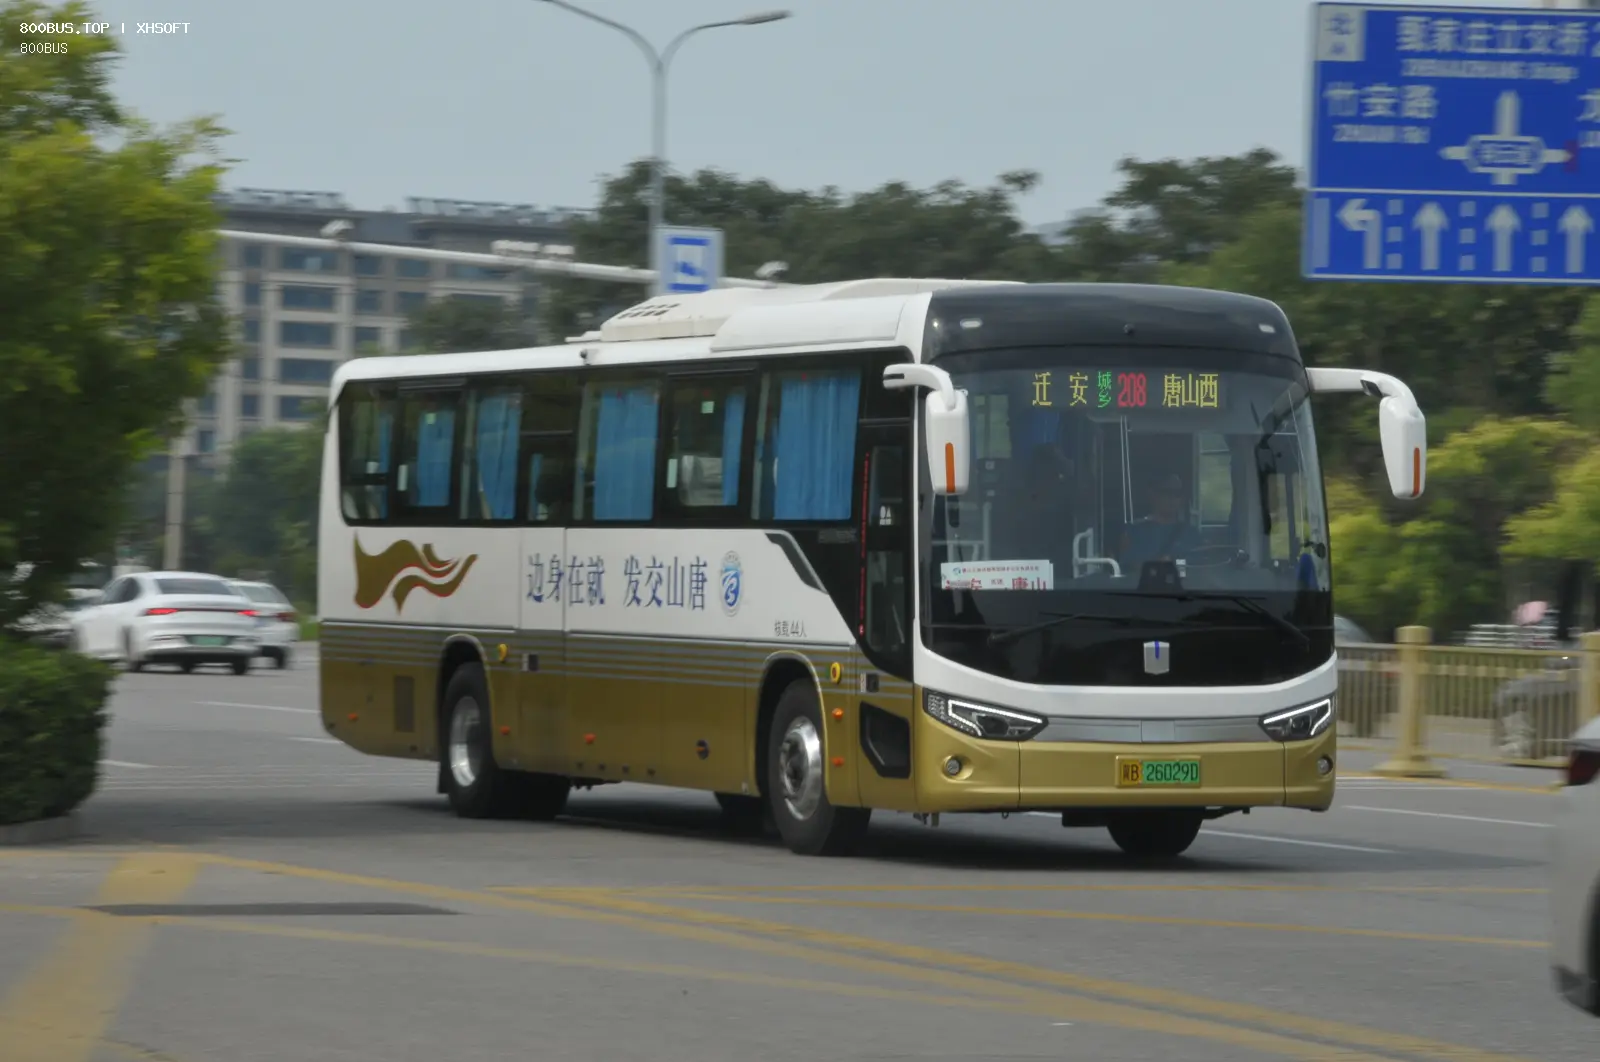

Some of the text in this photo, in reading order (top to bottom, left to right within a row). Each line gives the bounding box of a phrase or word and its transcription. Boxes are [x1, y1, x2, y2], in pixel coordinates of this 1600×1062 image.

[1117, 373, 1147, 407] 208
[1162, 373, 1219, 408] 唐山西
